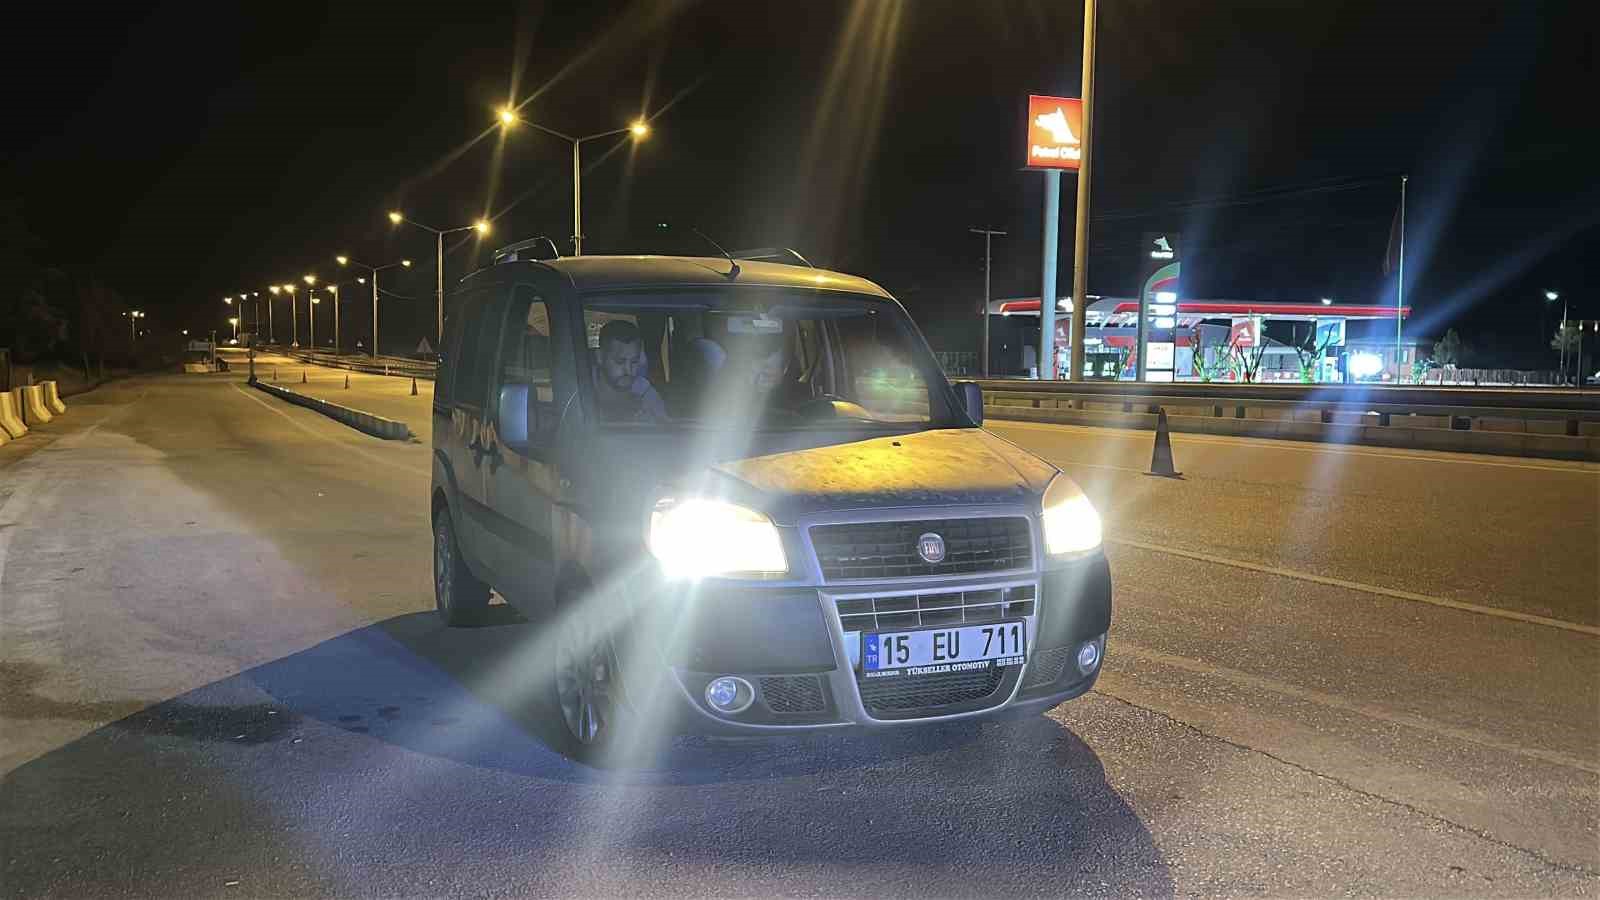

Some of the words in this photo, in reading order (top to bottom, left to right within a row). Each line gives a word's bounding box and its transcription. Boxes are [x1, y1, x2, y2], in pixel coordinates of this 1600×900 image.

[884, 636, 910, 665] 15
[933, 631, 960, 660] EU
[982, 625, 1019, 656] 711
[865, 654, 878, 665] TR
